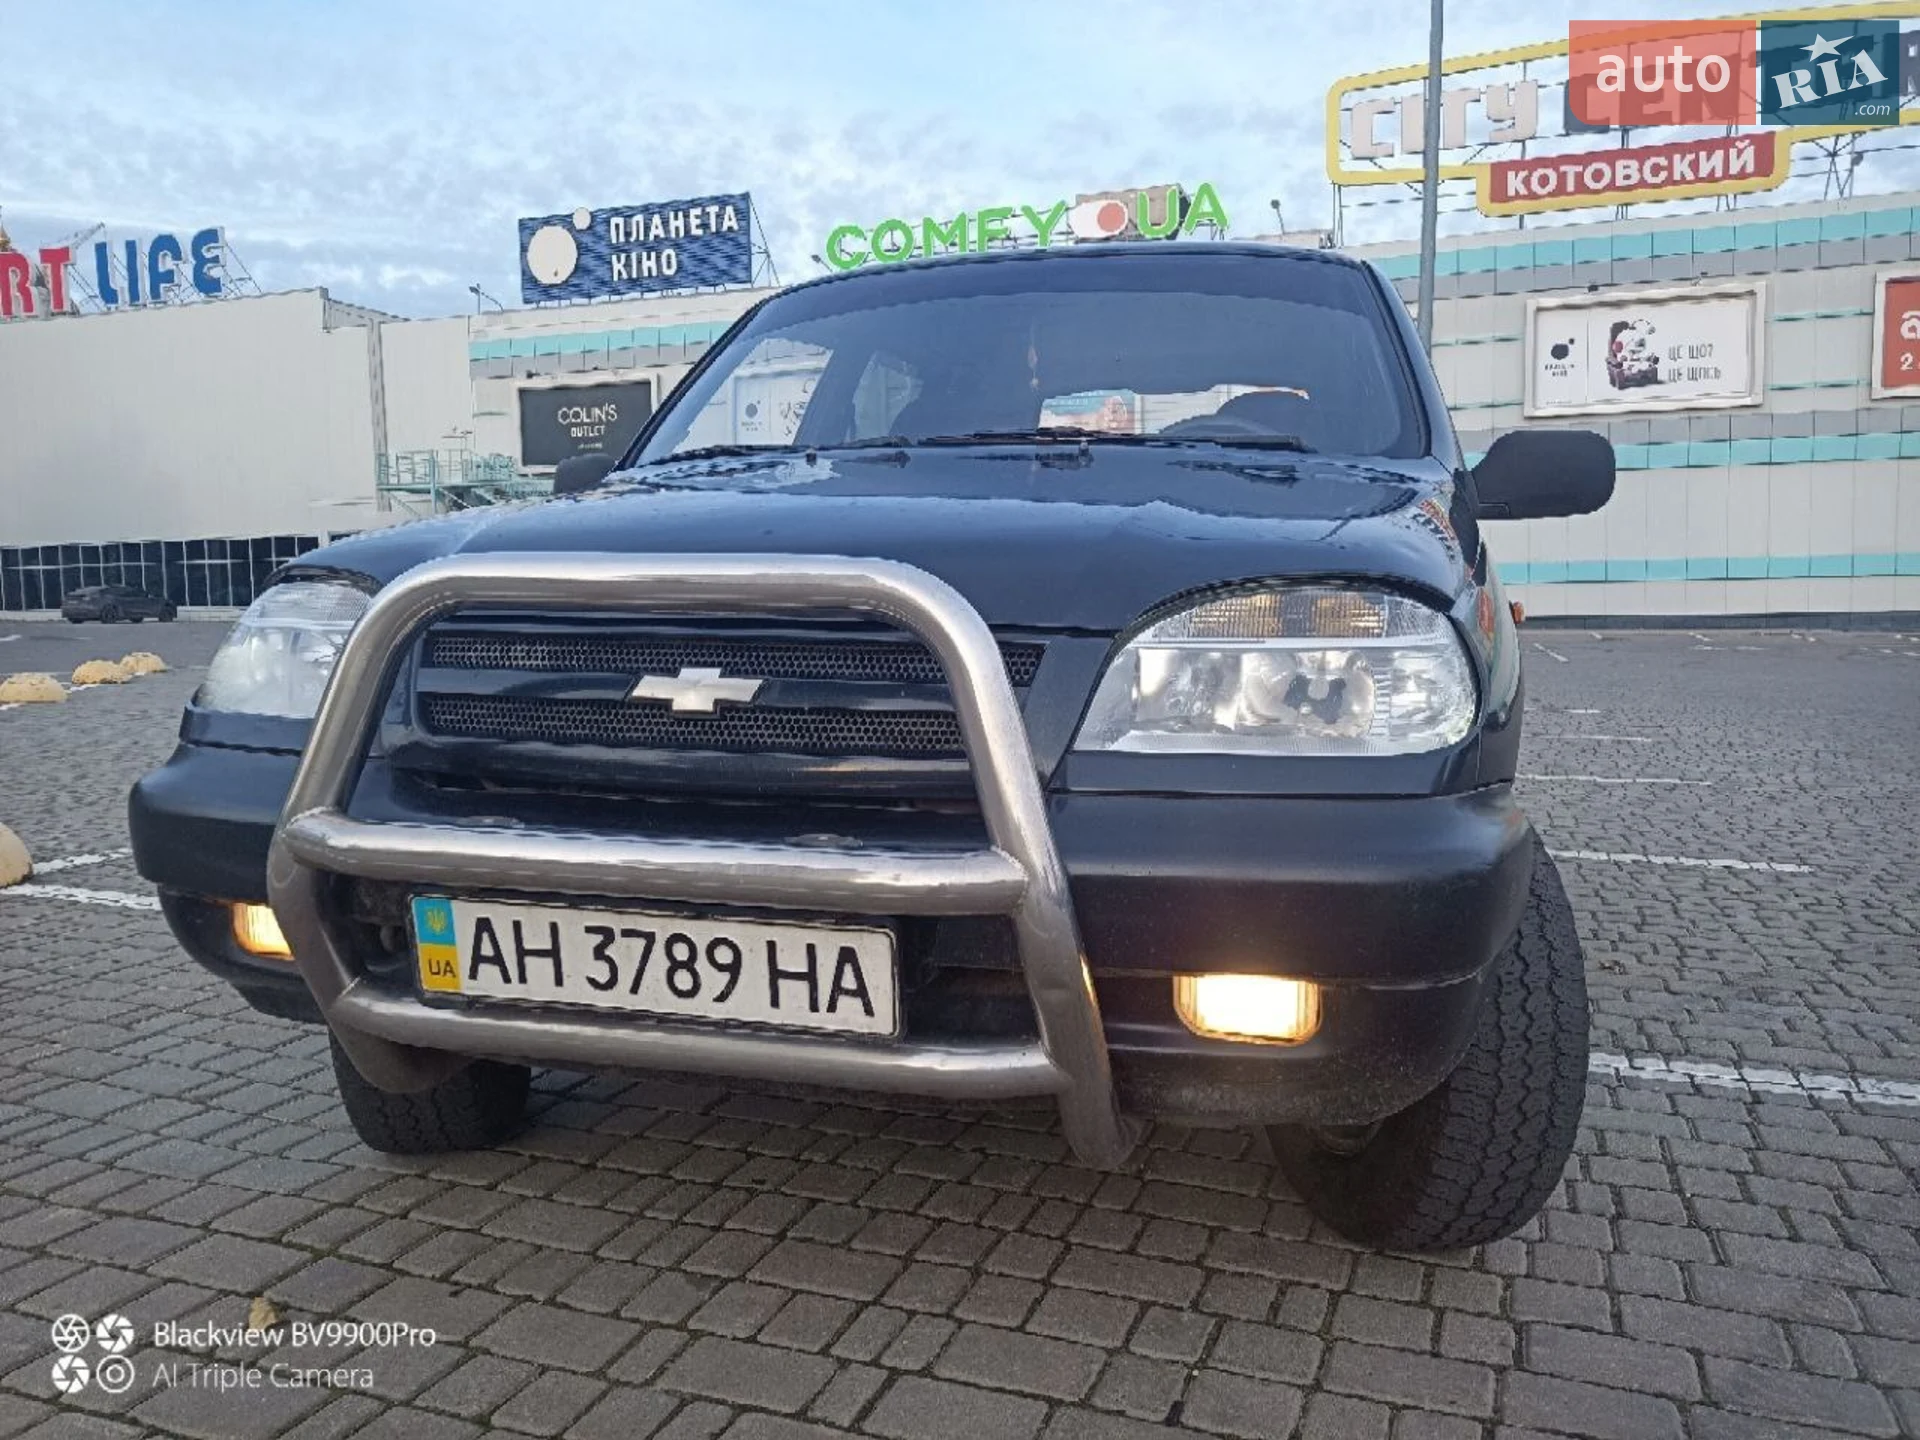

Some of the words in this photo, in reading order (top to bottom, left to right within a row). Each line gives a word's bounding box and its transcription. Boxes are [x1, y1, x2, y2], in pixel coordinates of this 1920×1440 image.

[1351, 80, 1537, 158] CITY
[1507, 139, 1755, 197] КОТОВСКИЙ
[609, 205, 739, 243] ПЛАНЕТА
[826, 200, 1067, 270] COMFY
[1136, 182, 1229, 238] UA
[95, 227, 224, 305] LIFE
[611, 248, 678, 281] КІНО
[557, 402, 617, 425] COLIN'S
[570, 425, 605, 437] OUTLET
[428, 959, 457, 979] UA
[468, 917, 564, 987] AH
[584, 926, 742, 1003] 3789
[767, 940, 875, 1017] HA
